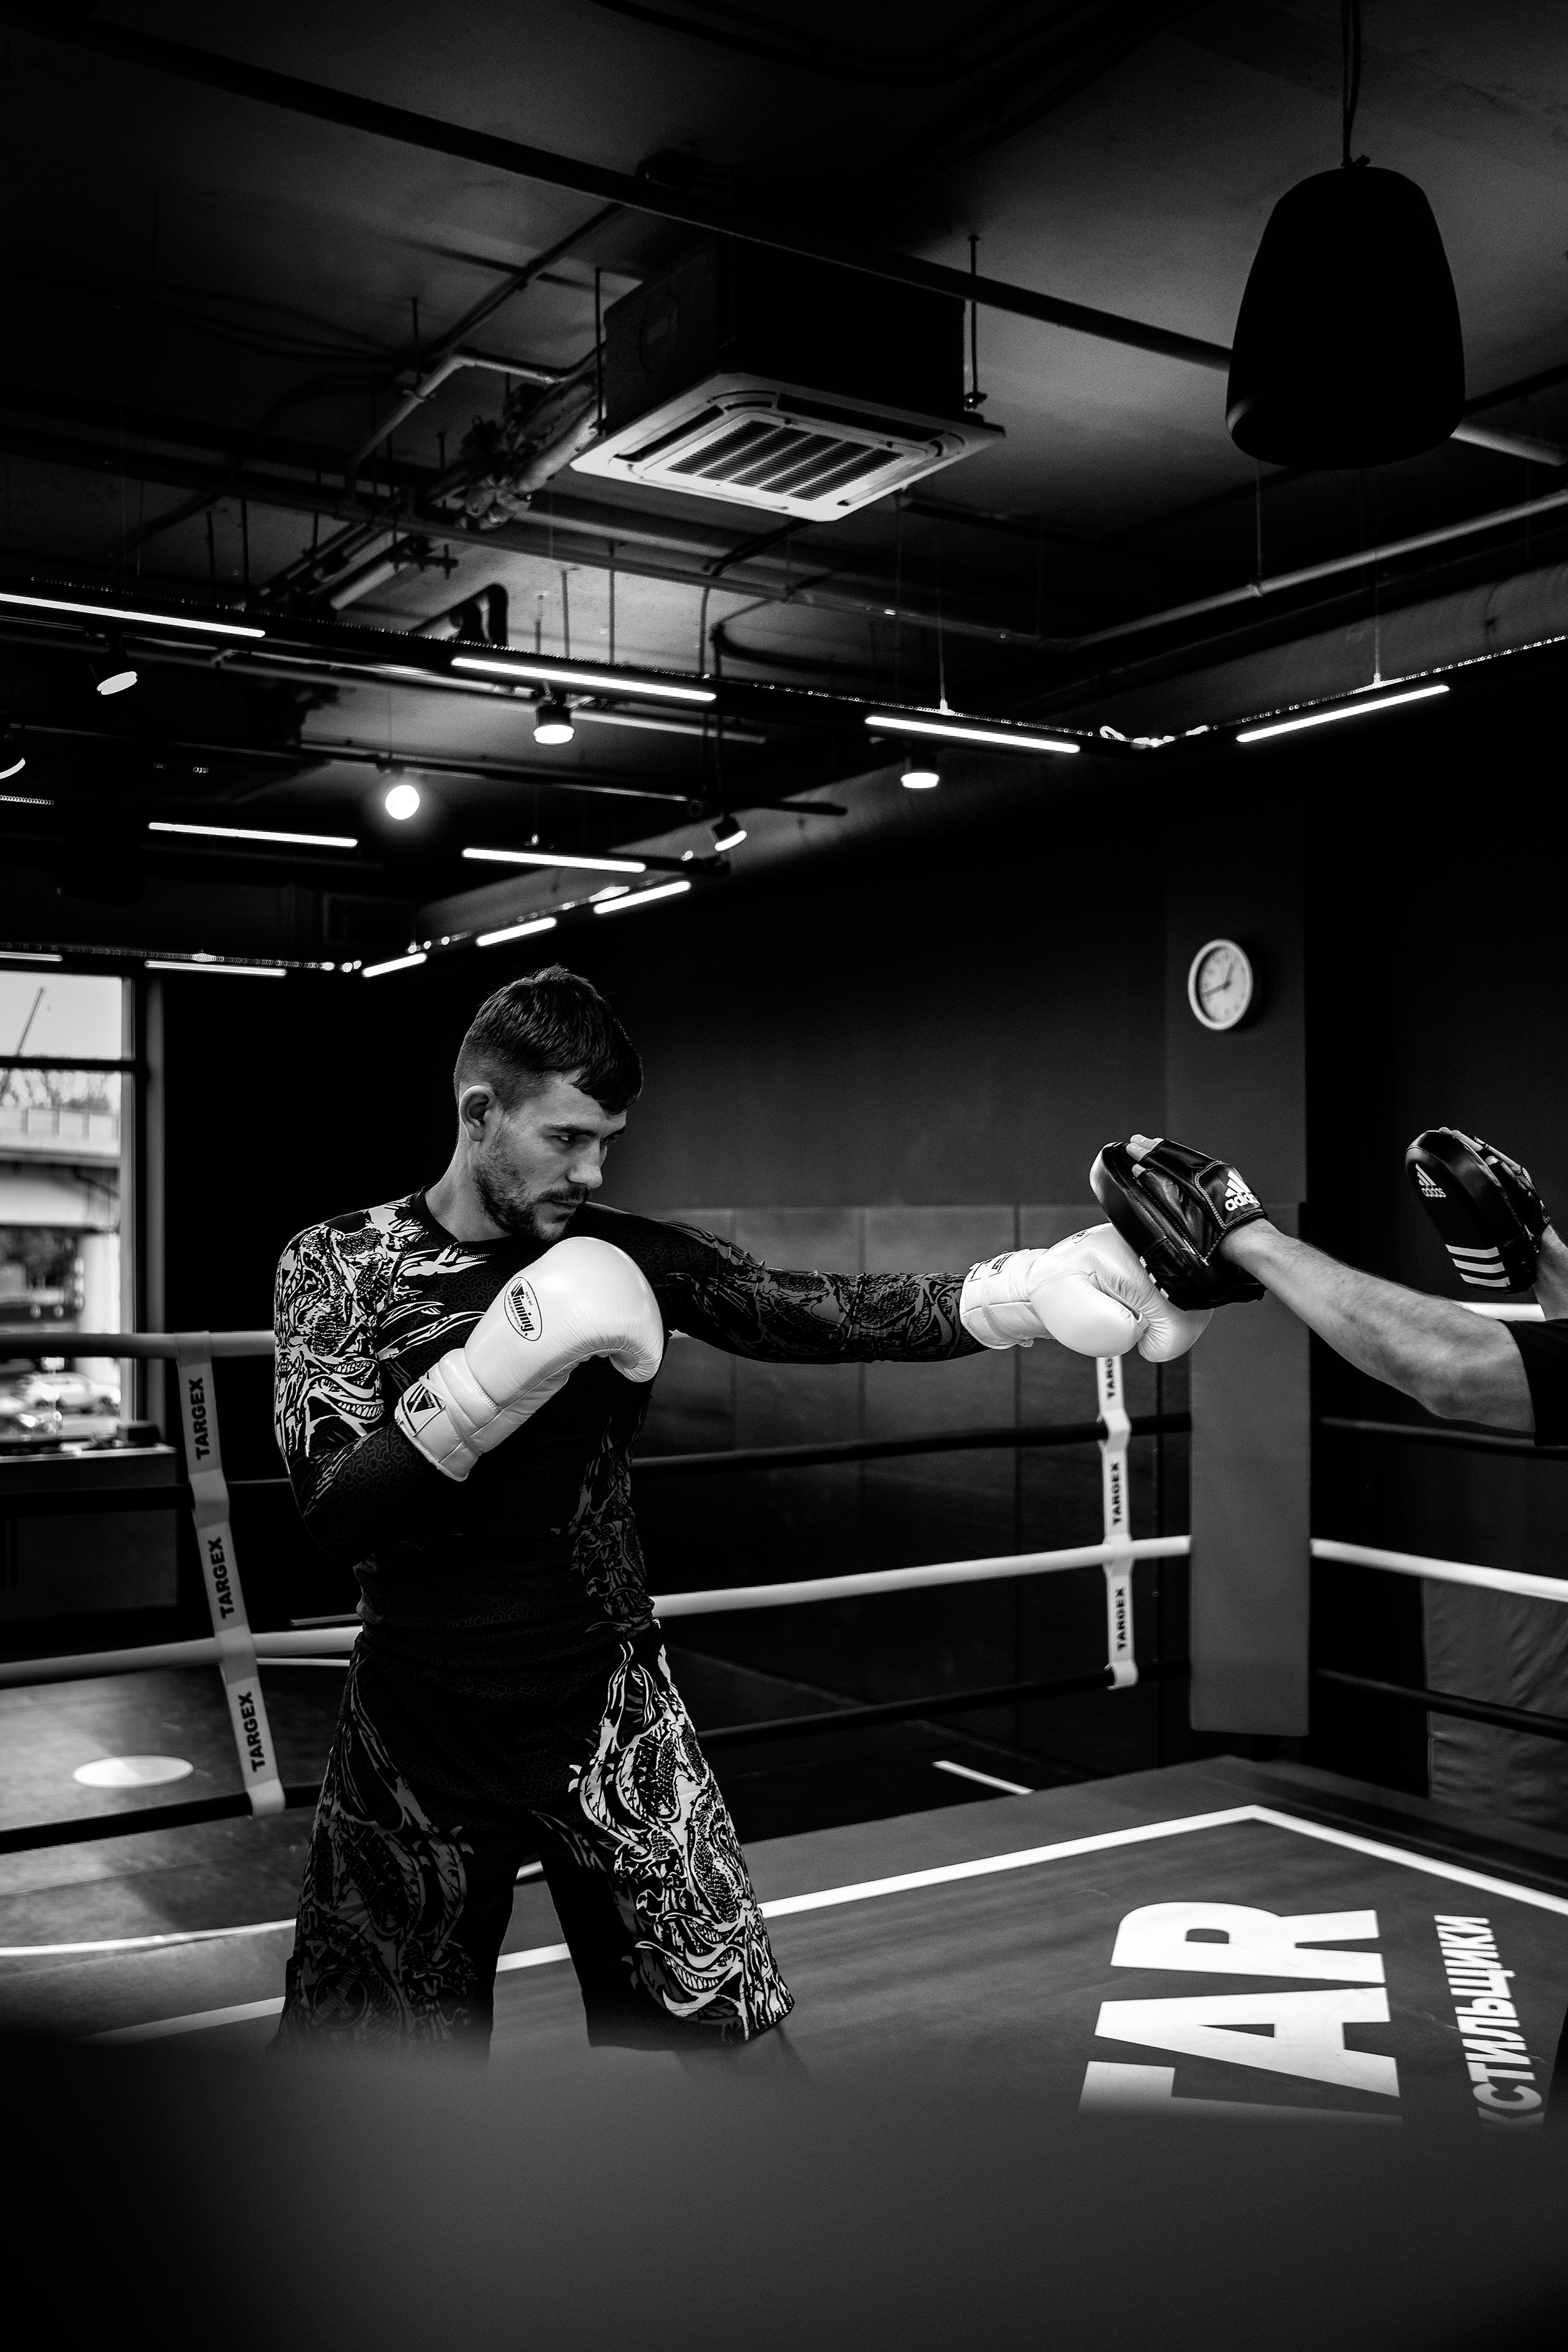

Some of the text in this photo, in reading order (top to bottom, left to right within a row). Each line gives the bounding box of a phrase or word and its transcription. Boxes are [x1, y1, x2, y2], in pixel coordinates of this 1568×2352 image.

[1224, 1191, 1261, 1212] adida
[511, 1280, 535, 1332] Winning
[1105, 1356, 1117, 1399] TARG
[189, 1378, 210, 1460] TARGEX
[1111, 1463, 1121, 1526] TARGEX
[208, 1536, 234, 1620] TARGEX
[1117, 1587, 1126, 1651] TARGEX
[238, 1691, 265, 1772] TARGEX
